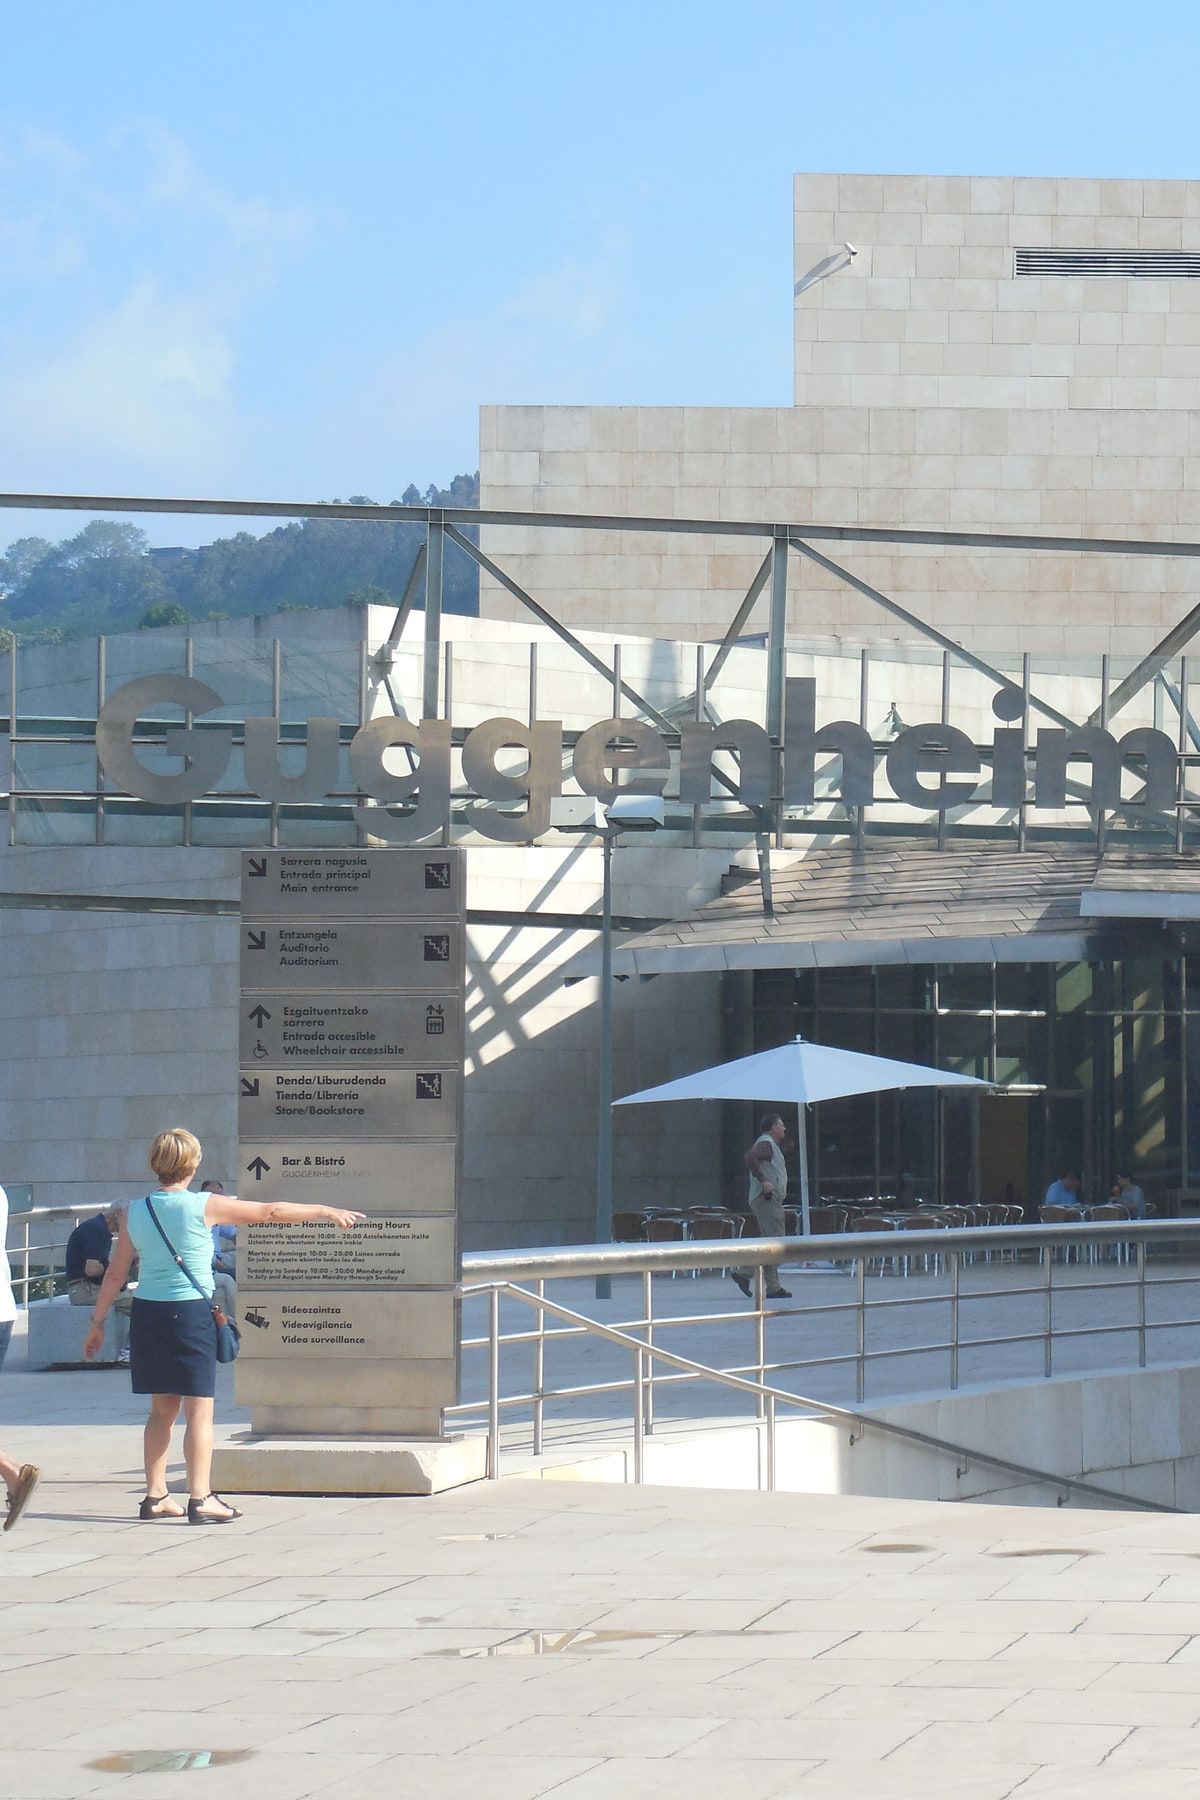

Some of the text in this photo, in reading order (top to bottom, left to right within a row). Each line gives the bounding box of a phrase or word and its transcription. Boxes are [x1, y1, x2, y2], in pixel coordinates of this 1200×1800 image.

[96, 674, 1179, 842] Guggenheim
[280, 857, 367, 868] Sarrera nagusia
[280, 870, 371, 881] Entrada principal
[280, 884, 359, 893] Main entrance
[279, 943, 330, 952] Auditorio
[279, 957, 339, 966] Auditorium
[282, 1031, 376, 1041] Entrada accesible
[282, 1045, 404, 1055] Wheelchair accessible
[276, 1075, 386, 1085] Denda/Liburudenda
[275, 1106, 365, 1115] Store/Bookstore
[282, 1156, 346, 1166] Bar & Bistró
[281, 1170, 340, 1178] GUGGENHEIM
[350, 1221, 383, 1230] pening
[385, 1221, 411, 1229] Hours
[281, 1306, 341, 1314] Bideozaintza
[281, 1321, 353, 1330] Videovigilancia
[281, 1335, 366, 1344] Video surveillance
